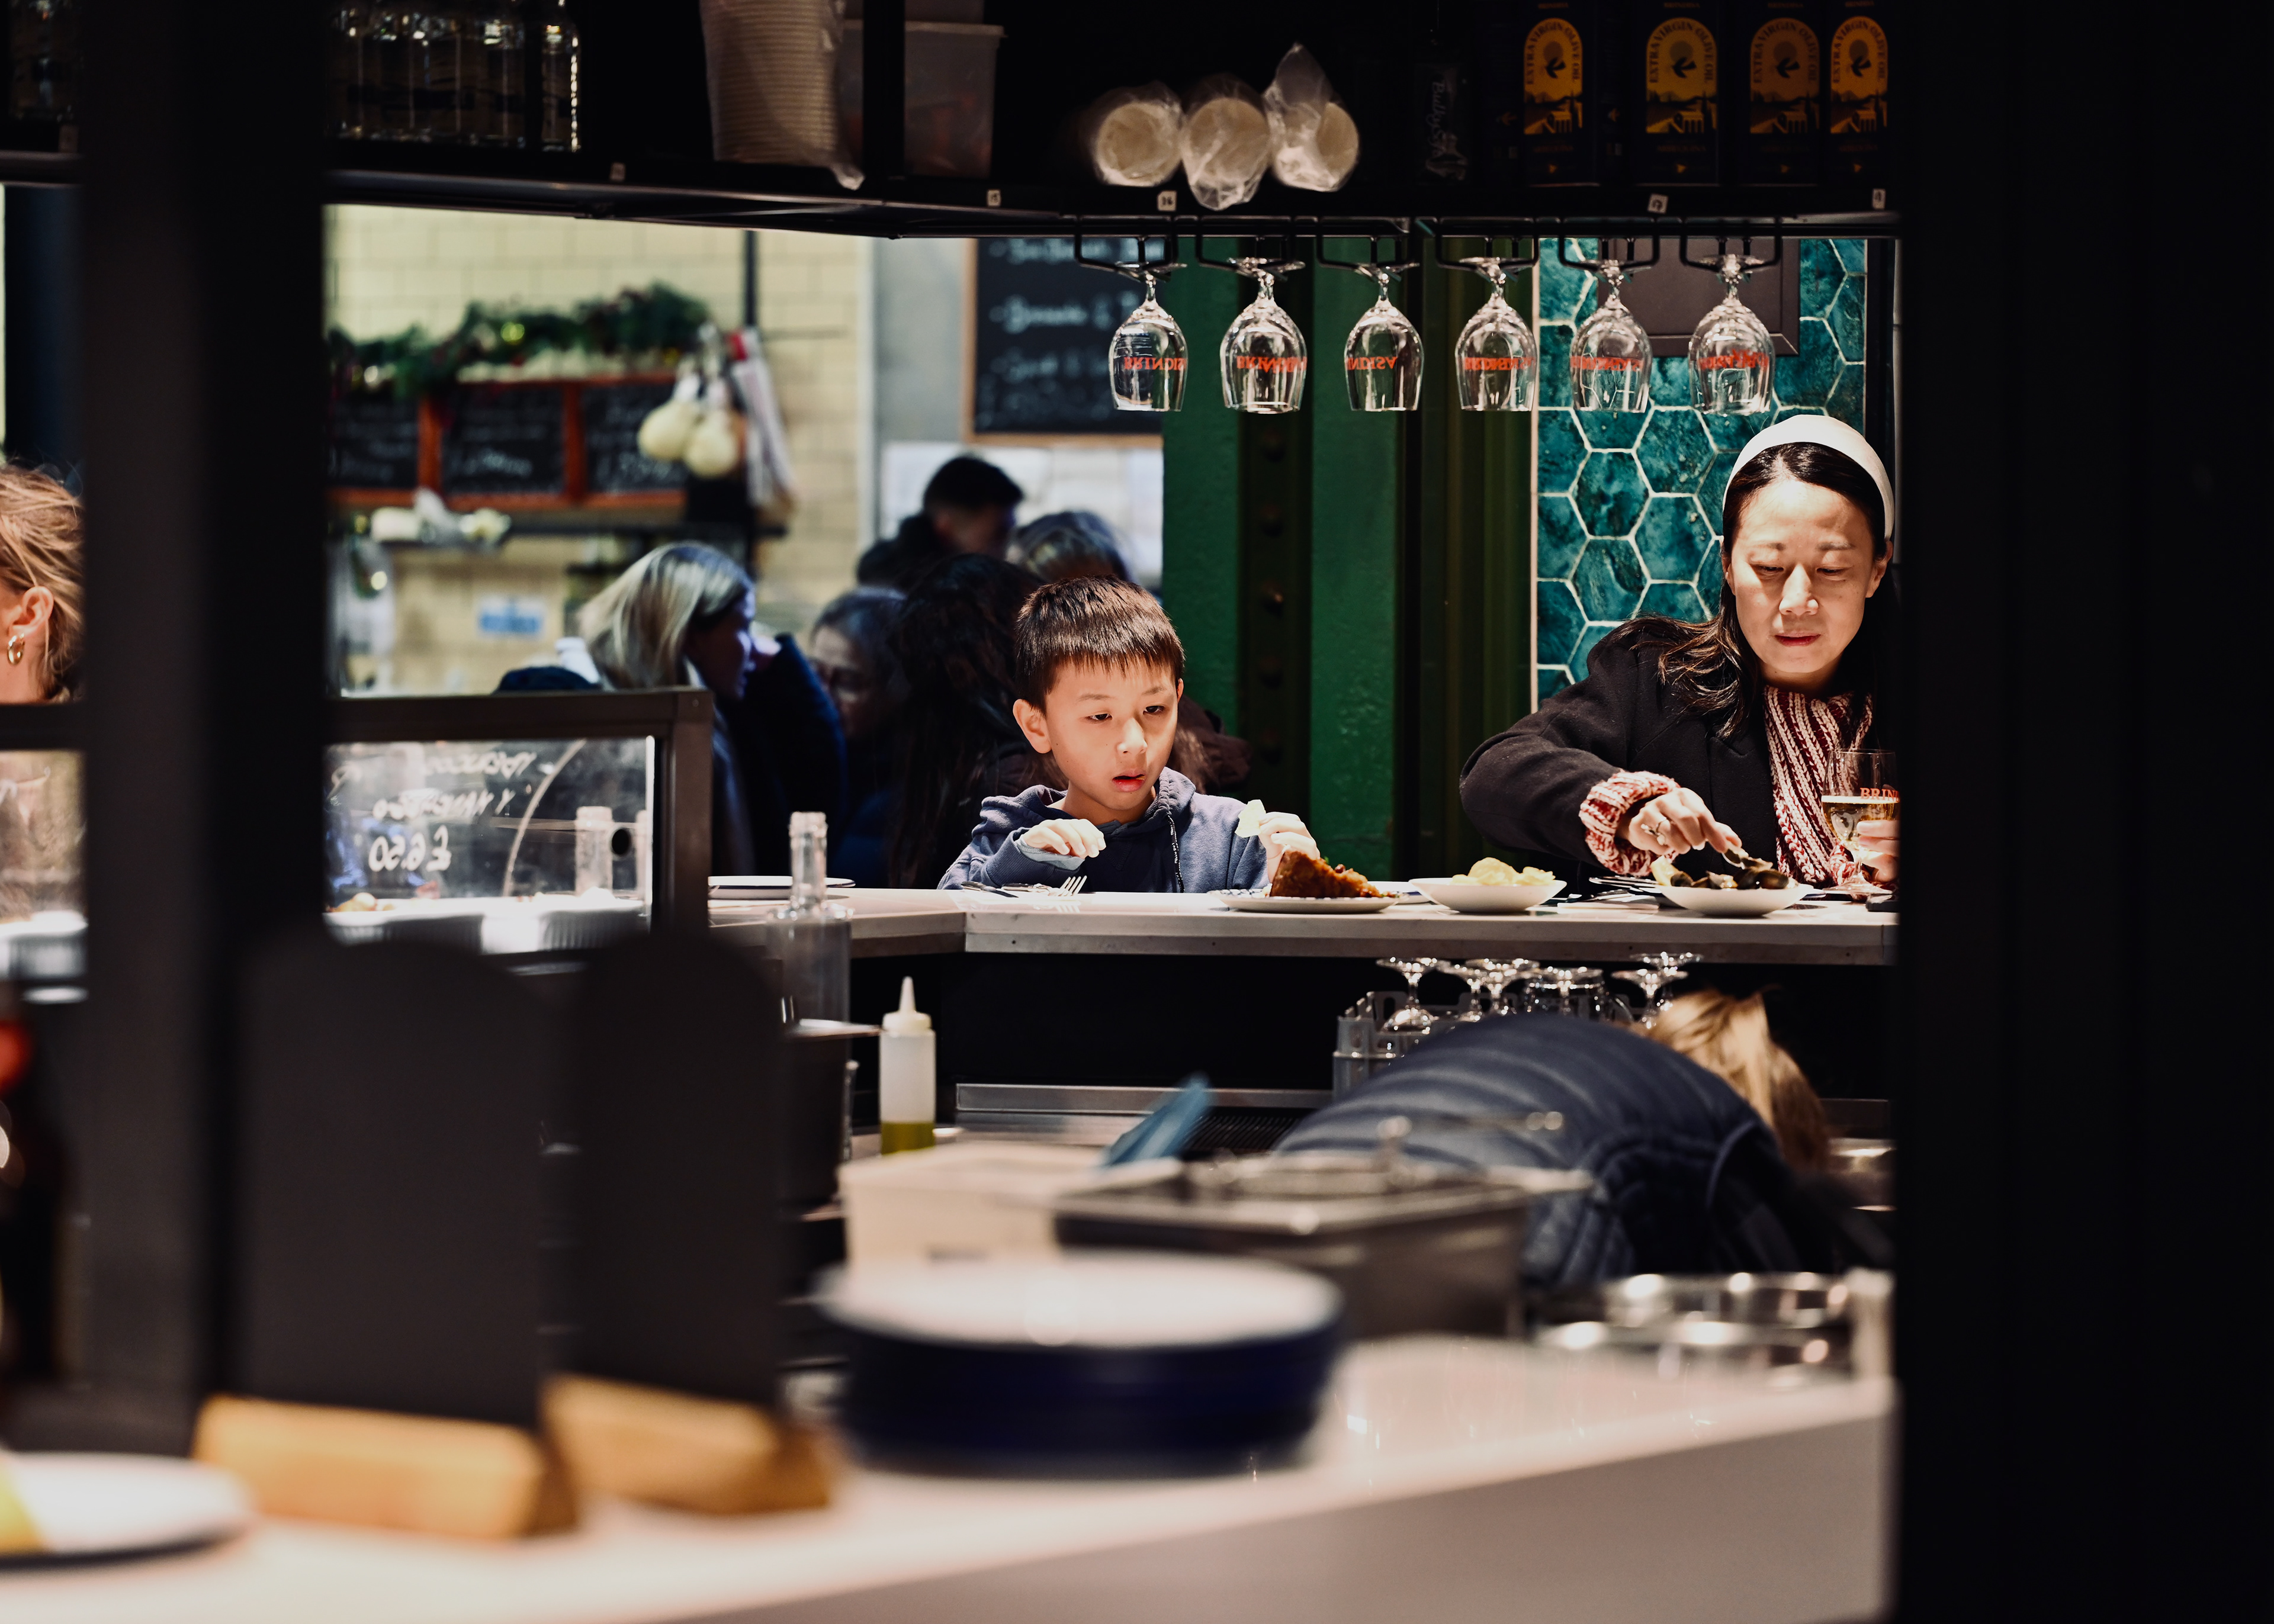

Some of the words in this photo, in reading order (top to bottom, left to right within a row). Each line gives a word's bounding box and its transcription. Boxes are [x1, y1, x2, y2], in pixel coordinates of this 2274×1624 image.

[1653, 21, 1693, 42] VIRGIN
[1757, 21, 1797, 42] VIRGIN
[1836, 20, 1869, 41] VIRGIN
[1649, 43, 1660, 83] EXTRA
[1753, 43, 1764, 83] EXTRA
